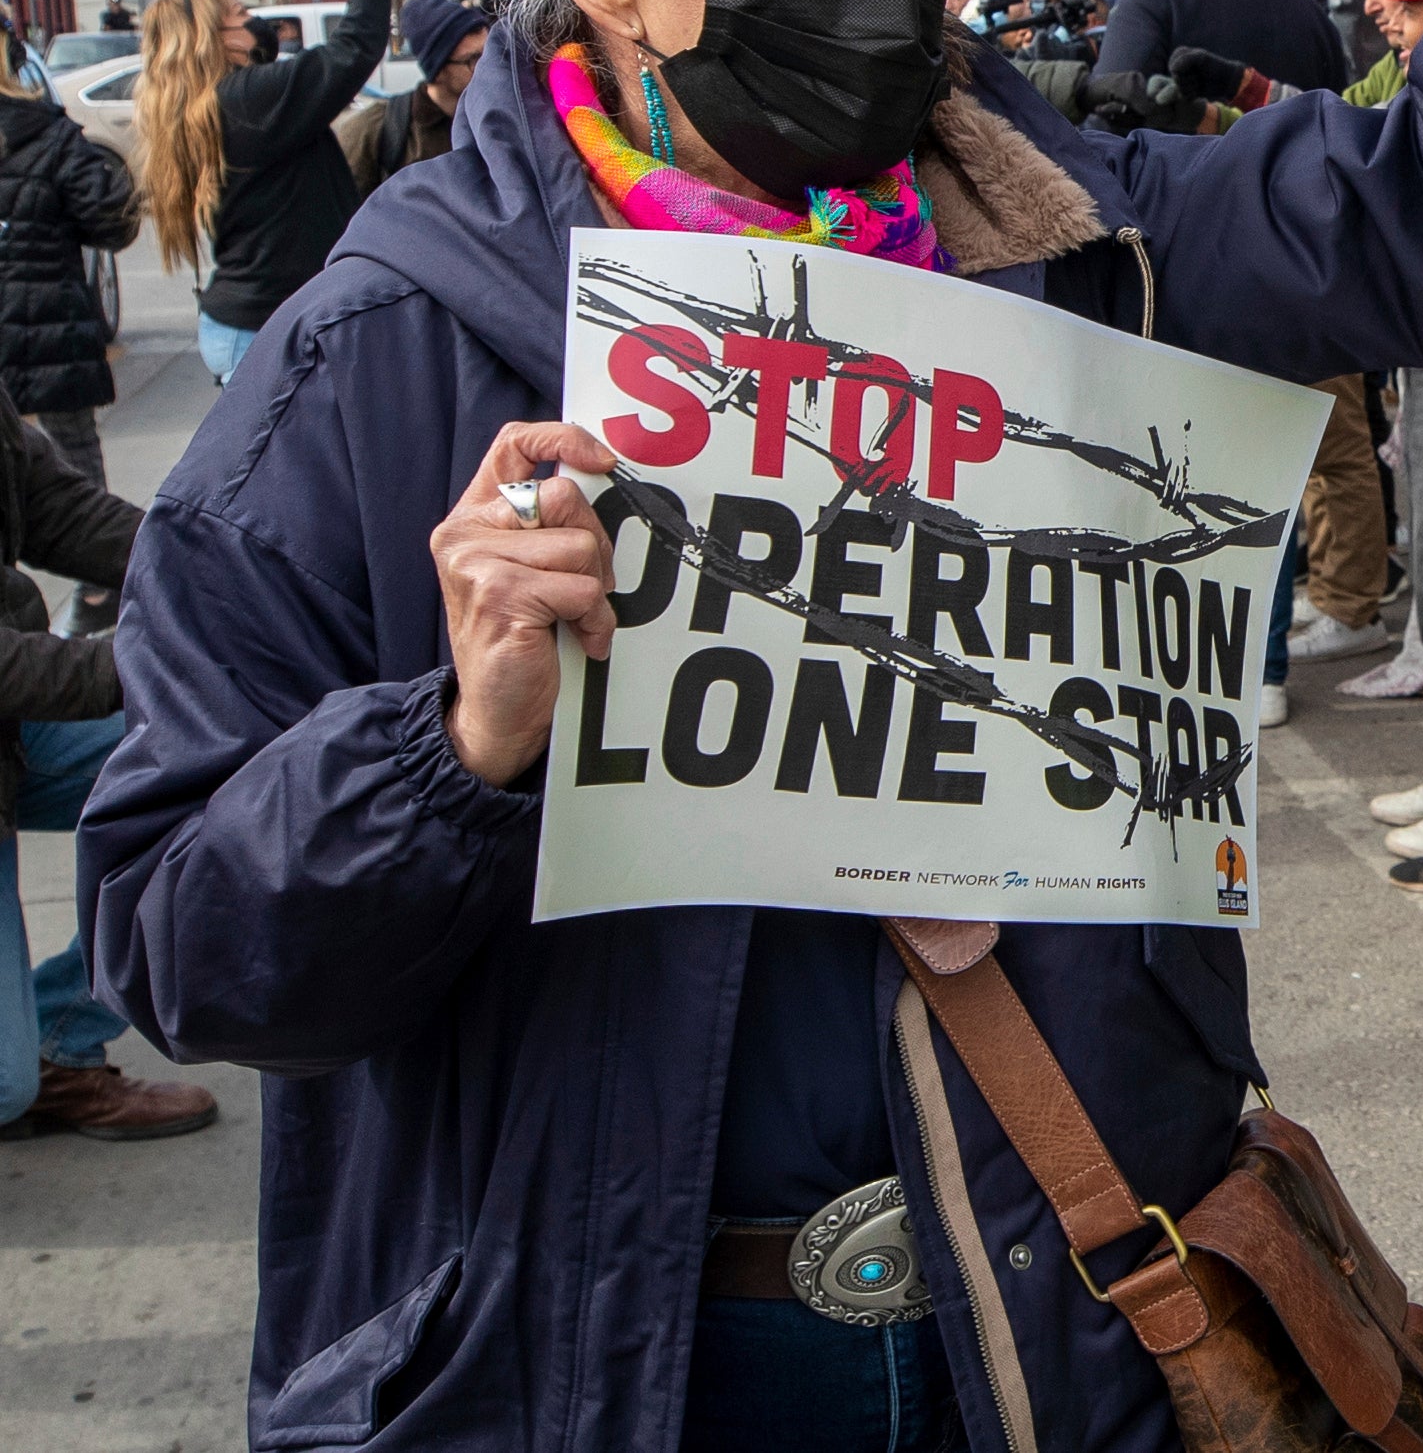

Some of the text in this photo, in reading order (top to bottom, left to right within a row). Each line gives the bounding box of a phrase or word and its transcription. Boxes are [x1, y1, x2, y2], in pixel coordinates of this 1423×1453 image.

[603, 323, 1004, 501] STOP
[592, 481, 1251, 701] OPERATION
[575, 647, 1248, 828] LONE STAR
[834, 866, 1147, 891] BORDER NETWORK For HUMAN RIGHTS
